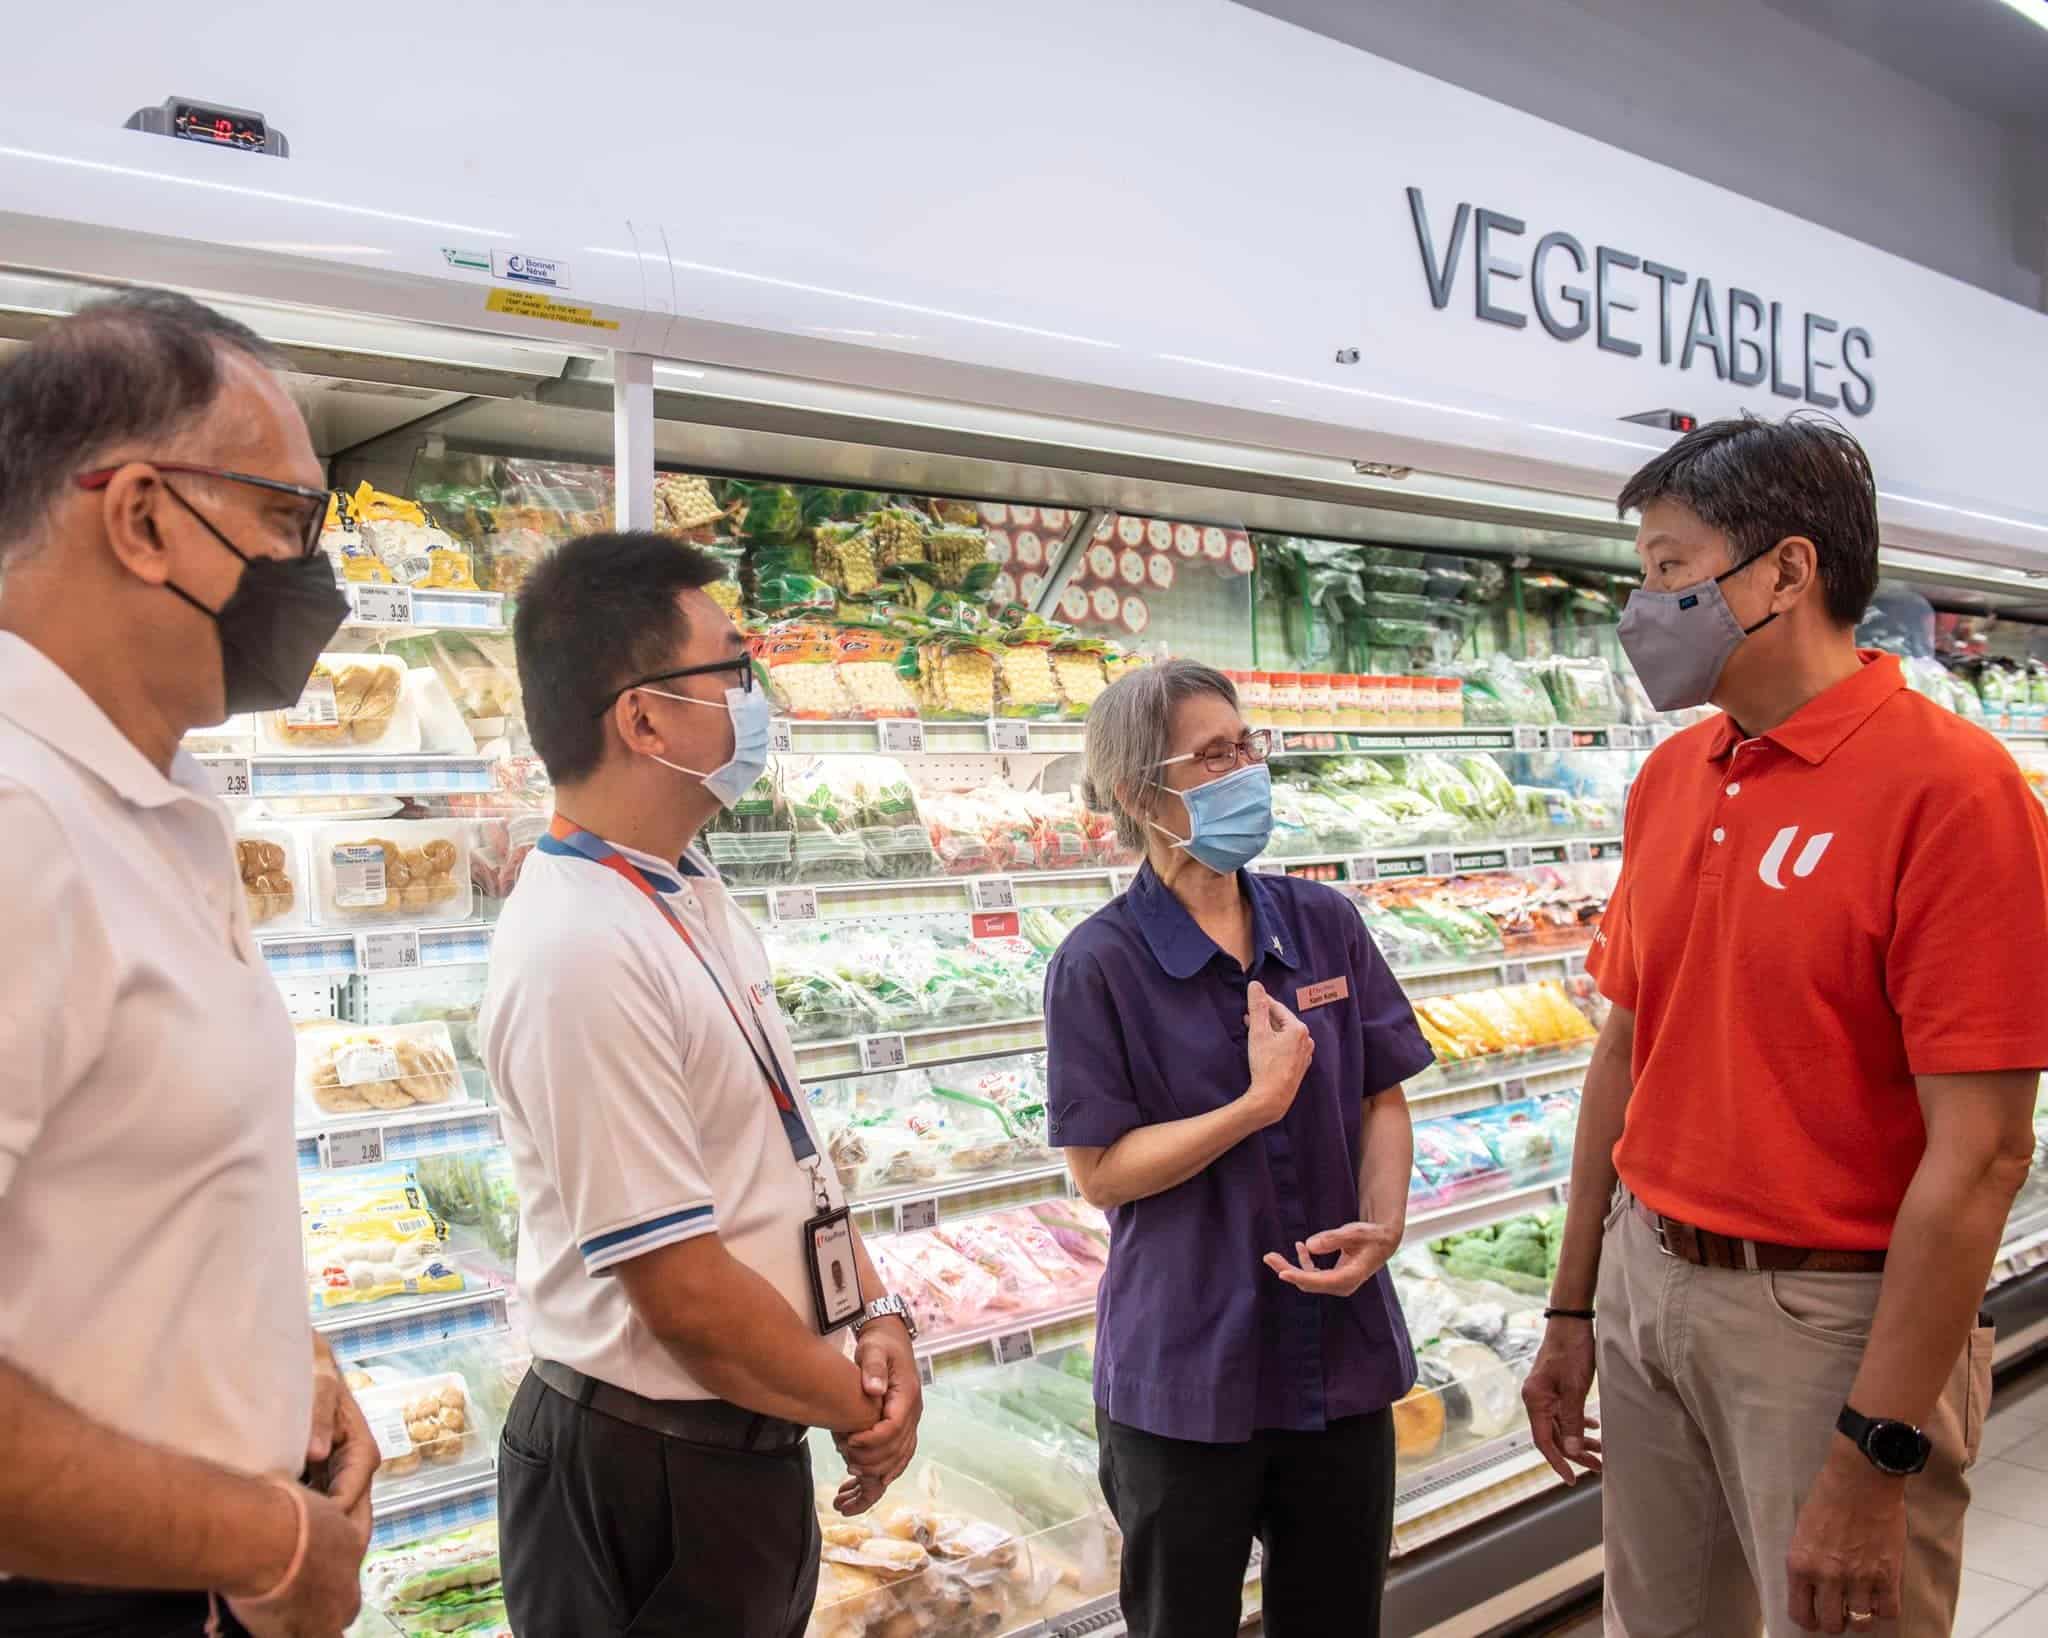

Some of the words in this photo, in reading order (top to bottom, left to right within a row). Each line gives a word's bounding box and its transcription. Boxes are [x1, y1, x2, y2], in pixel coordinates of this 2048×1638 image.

[1406, 186, 1877, 417] VEGETABLES
[391, 603, 408, 618] 3.30
[226, 775, 247, 791] 2.35
